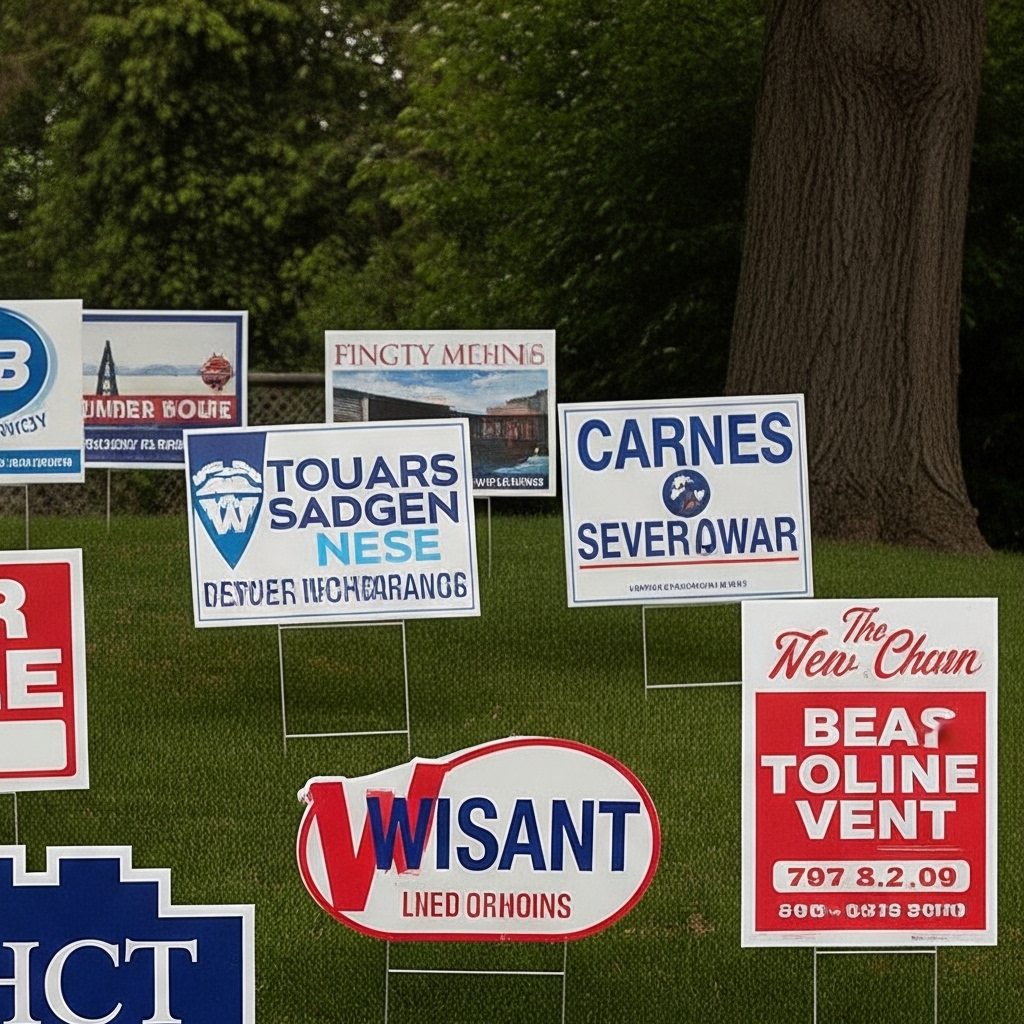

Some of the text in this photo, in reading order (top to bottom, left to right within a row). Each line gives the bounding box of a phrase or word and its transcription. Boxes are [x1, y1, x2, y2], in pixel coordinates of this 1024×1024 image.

[334, 344, 434, 365] FINGTY
[577, 411, 793, 471] CARNES
[267, 454, 459, 492] TOUARS
[269, 491, 460, 529] SADGEN
[317, 529, 442, 567] NESE
[842, 606, 888, 643] The
[768, 629, 860, 679] New
[760, 754, 979, 794] TOLINE
[366, 796, 641, 872] WISANT
[794, 800, 957, 840] VENT
[787, 867, 845, 887] 797
[402, 891, 460, 917] LNED
